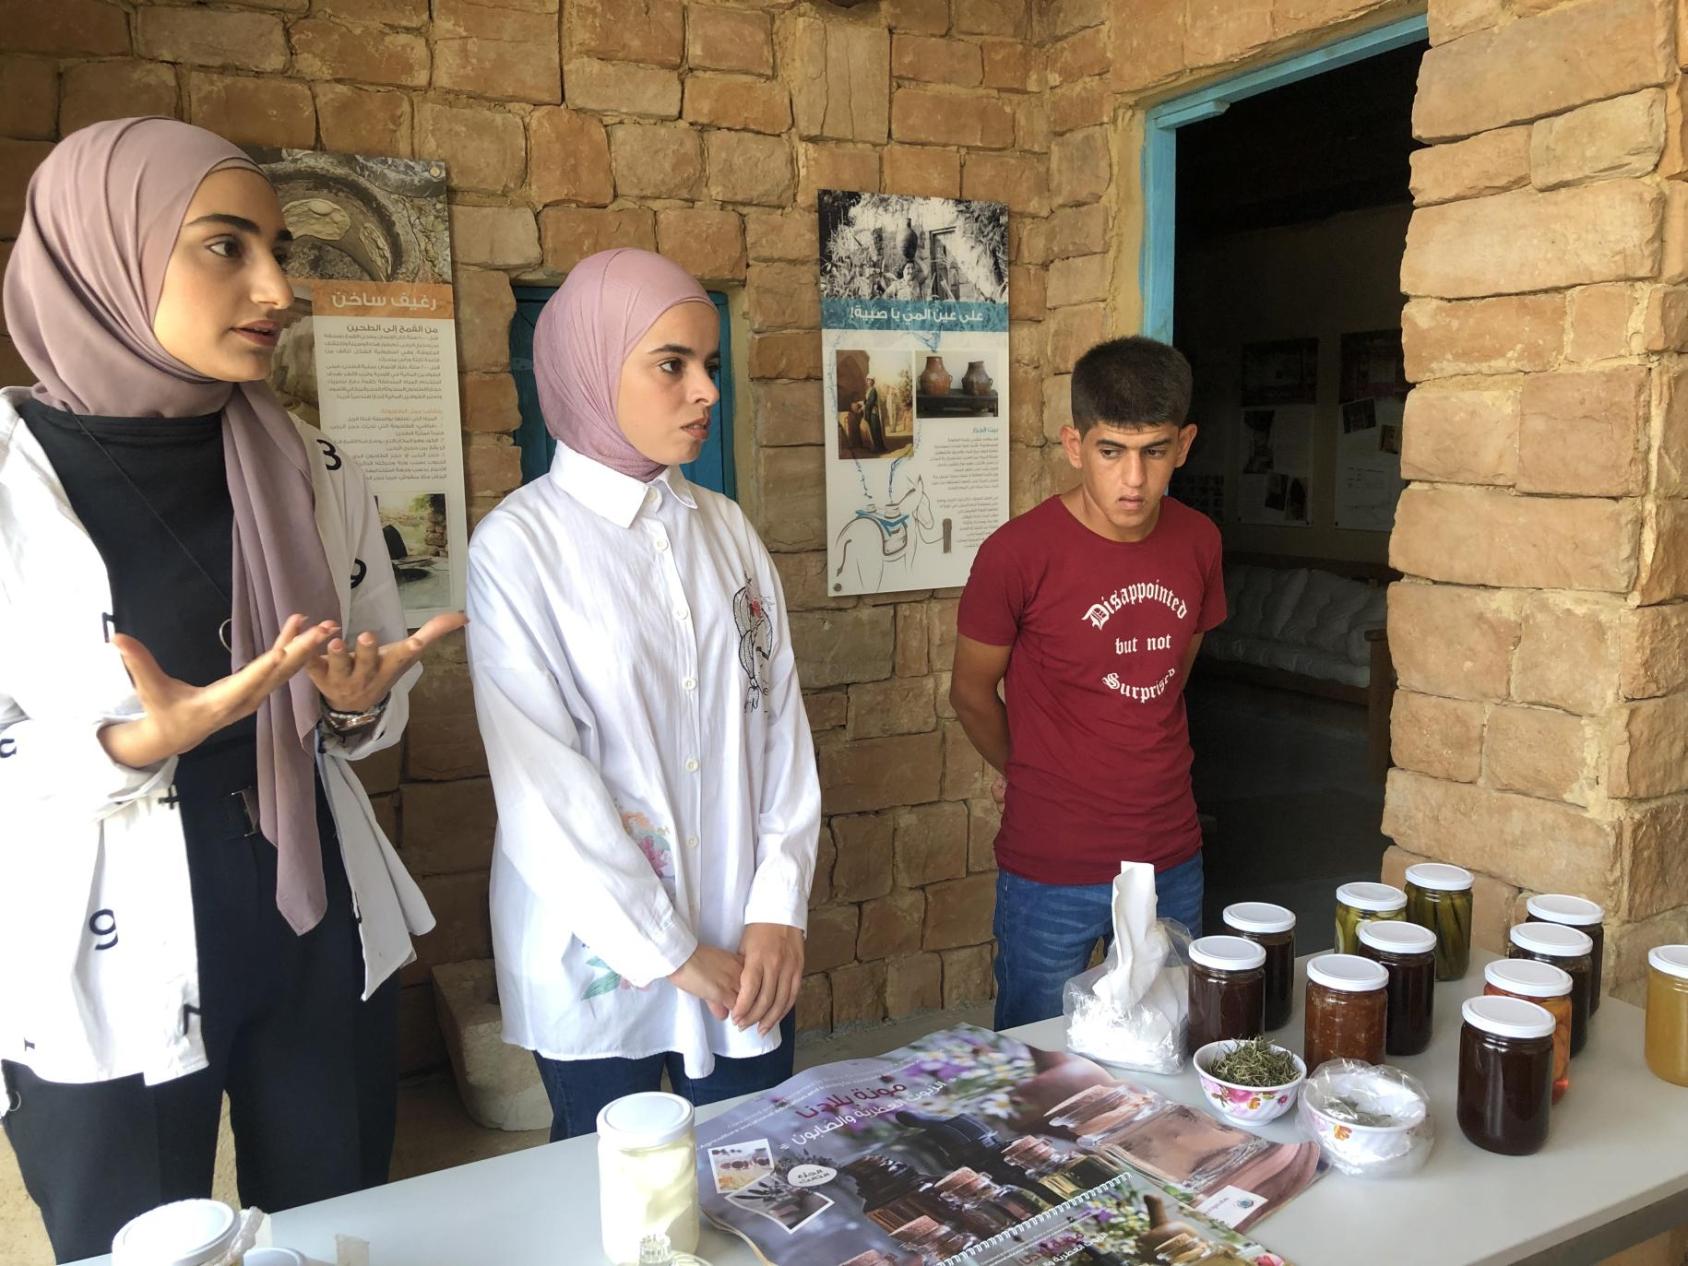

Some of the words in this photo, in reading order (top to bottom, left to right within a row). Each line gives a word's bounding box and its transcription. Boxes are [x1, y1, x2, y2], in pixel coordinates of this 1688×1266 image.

[332, 291, 386, 308] ساخن
[390, 292, 437, 311] رغيف
[890, 307, 900, 321] يا
[933, 308, 957, 323] عين
[959, 309, 983, 323] على
[398, 325, 424, 334] القمح
[424, 326, 438, 334] من
[316, 439, 342, 471] 3
[1081, 579, 1187, 630] Disappointed
[1115, 637, 1138, 655] but
[1147, 634, 1172, 651] not
[89, 909, 119, 950] 9
[851, 1084, 907, 1100] مونة
[795, 1094, 859, 1119] بلادنا
[791, 1115, 857, 1146] والصابون
